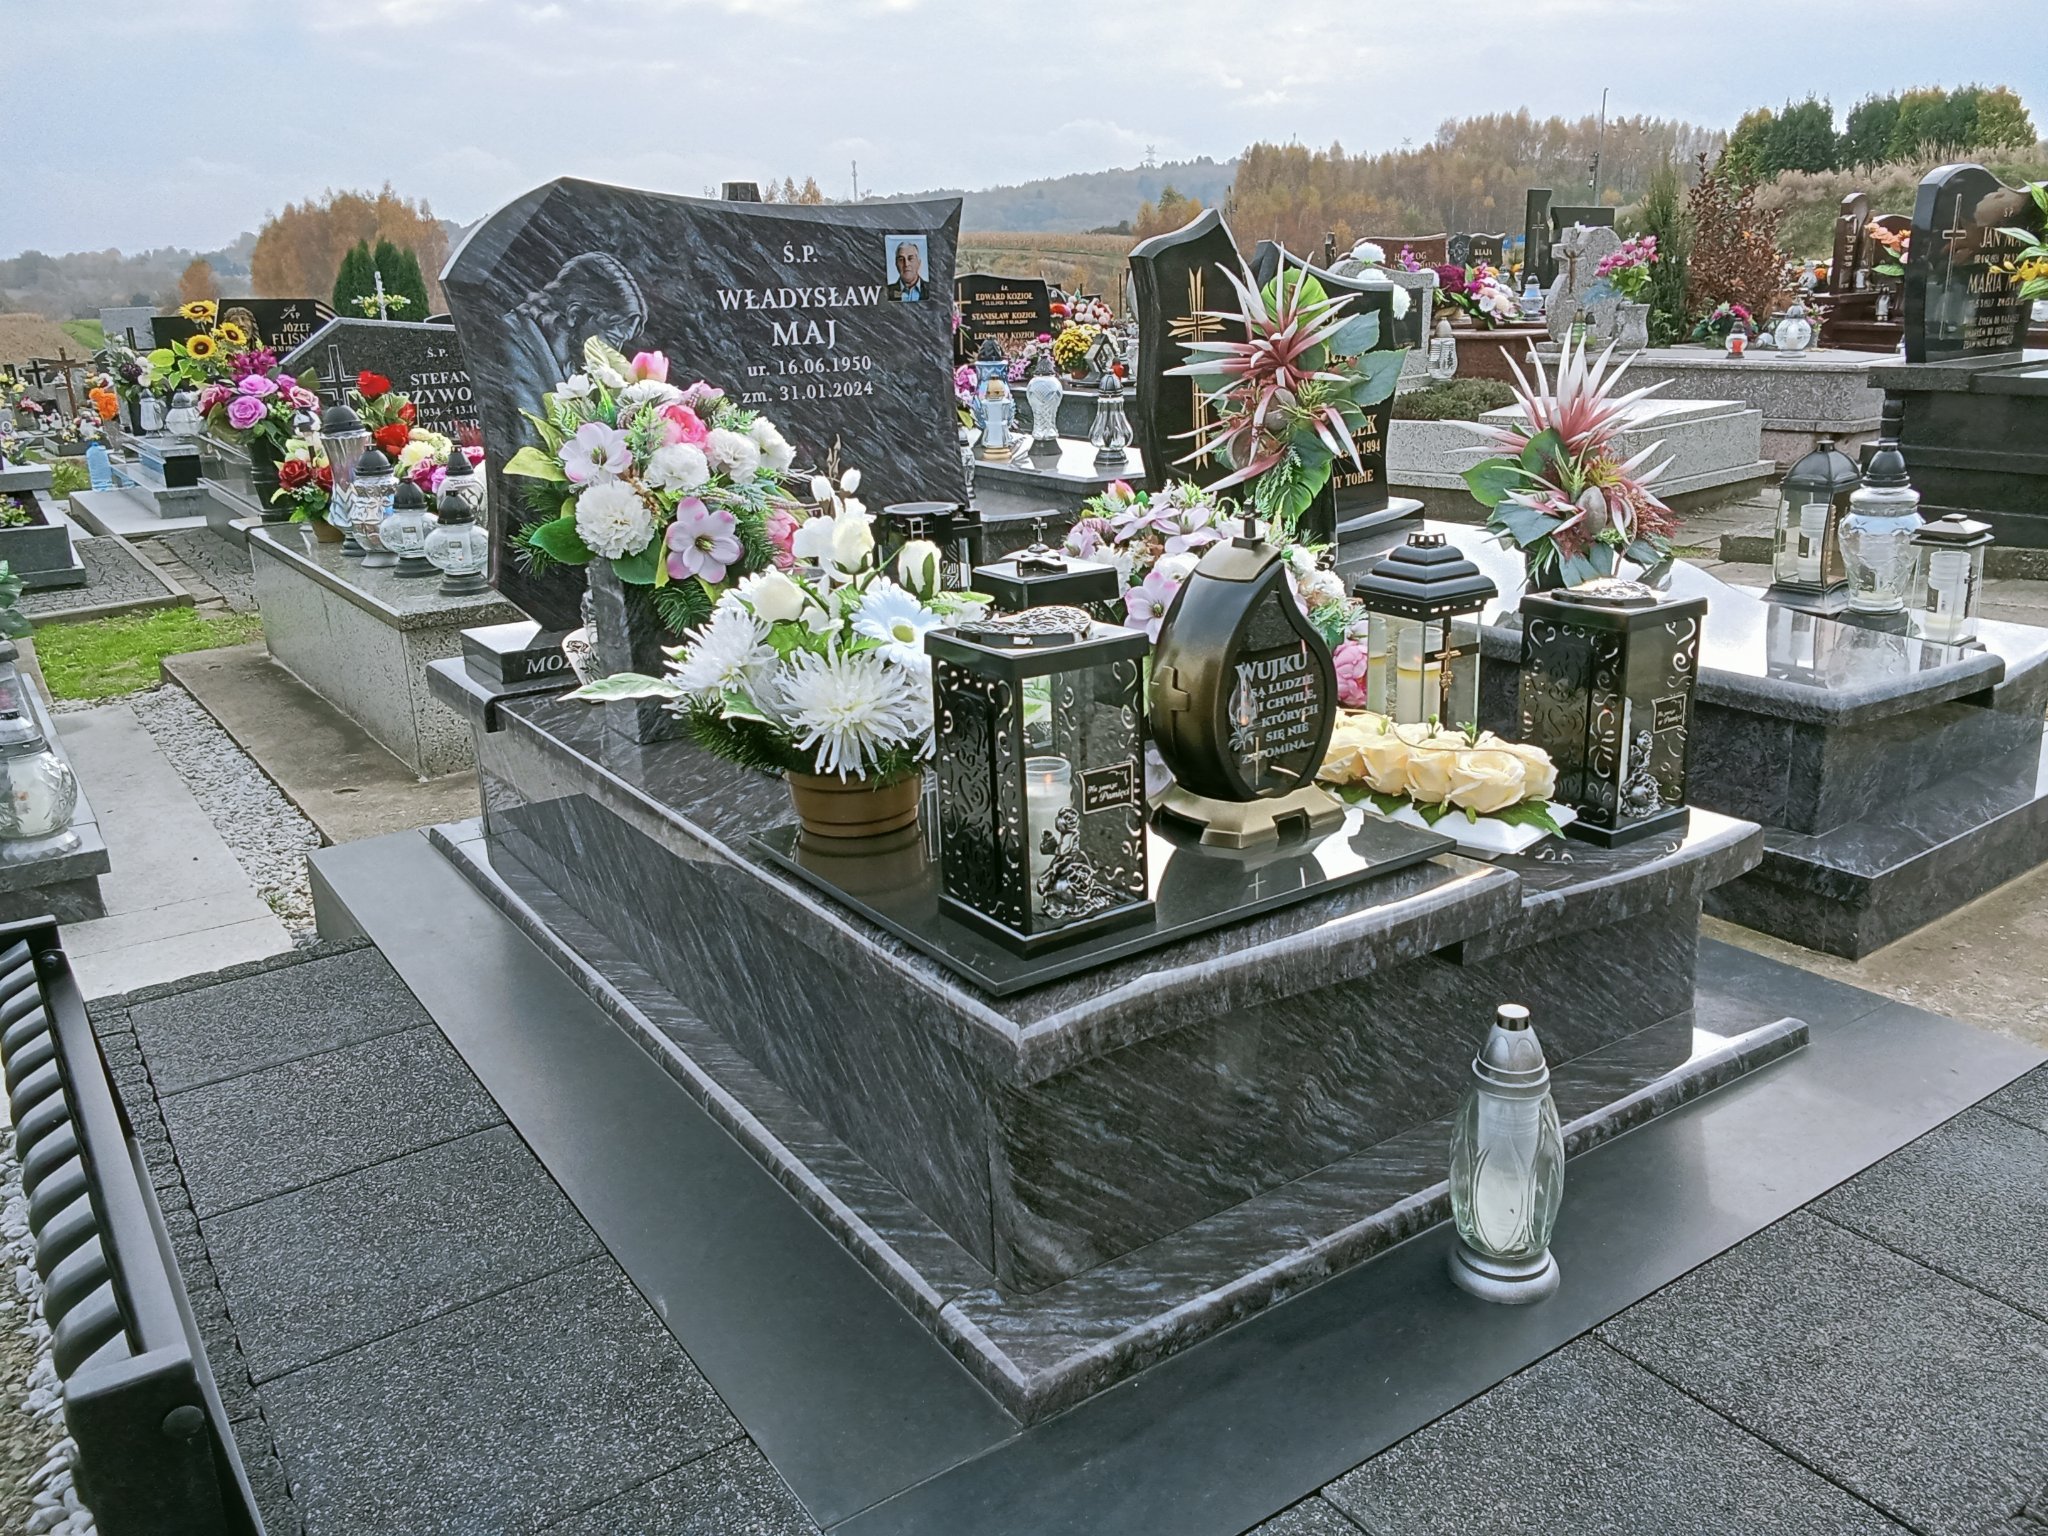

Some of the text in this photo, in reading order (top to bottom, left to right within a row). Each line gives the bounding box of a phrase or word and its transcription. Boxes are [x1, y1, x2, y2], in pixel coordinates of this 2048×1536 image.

[783, 241, 818, 263] Ś.P.
[1967, 272, 2001, 294] MARIA
[717, 285, 882, 311] WŁADYSŁAW
[975, 293, 1006, 301] EDWARD
[971, 312, 1010, 320] STANISŁAW
[282, 322, 311, 333] JÓZEF
[771, 319, 837, 350] MAJ
[747, 355, 872, 377] ur. 16.06.1950
[410, 371, 471, 386] STEFAN
[742, 381, 873, 404] zm. 31.01.2024
[1345, 469, 1374, 486] TOBIE
[1235, 652, 1308, 682] WUJKU
[1251, 674, 1314, 698] SĄ LUDZIE
[1266, 689, 1317, 710] CHWILE,
[1261, 704, 1318, 728] KTÓRYCH
[1265, 722, 1309, 742] SIĘ NIE
